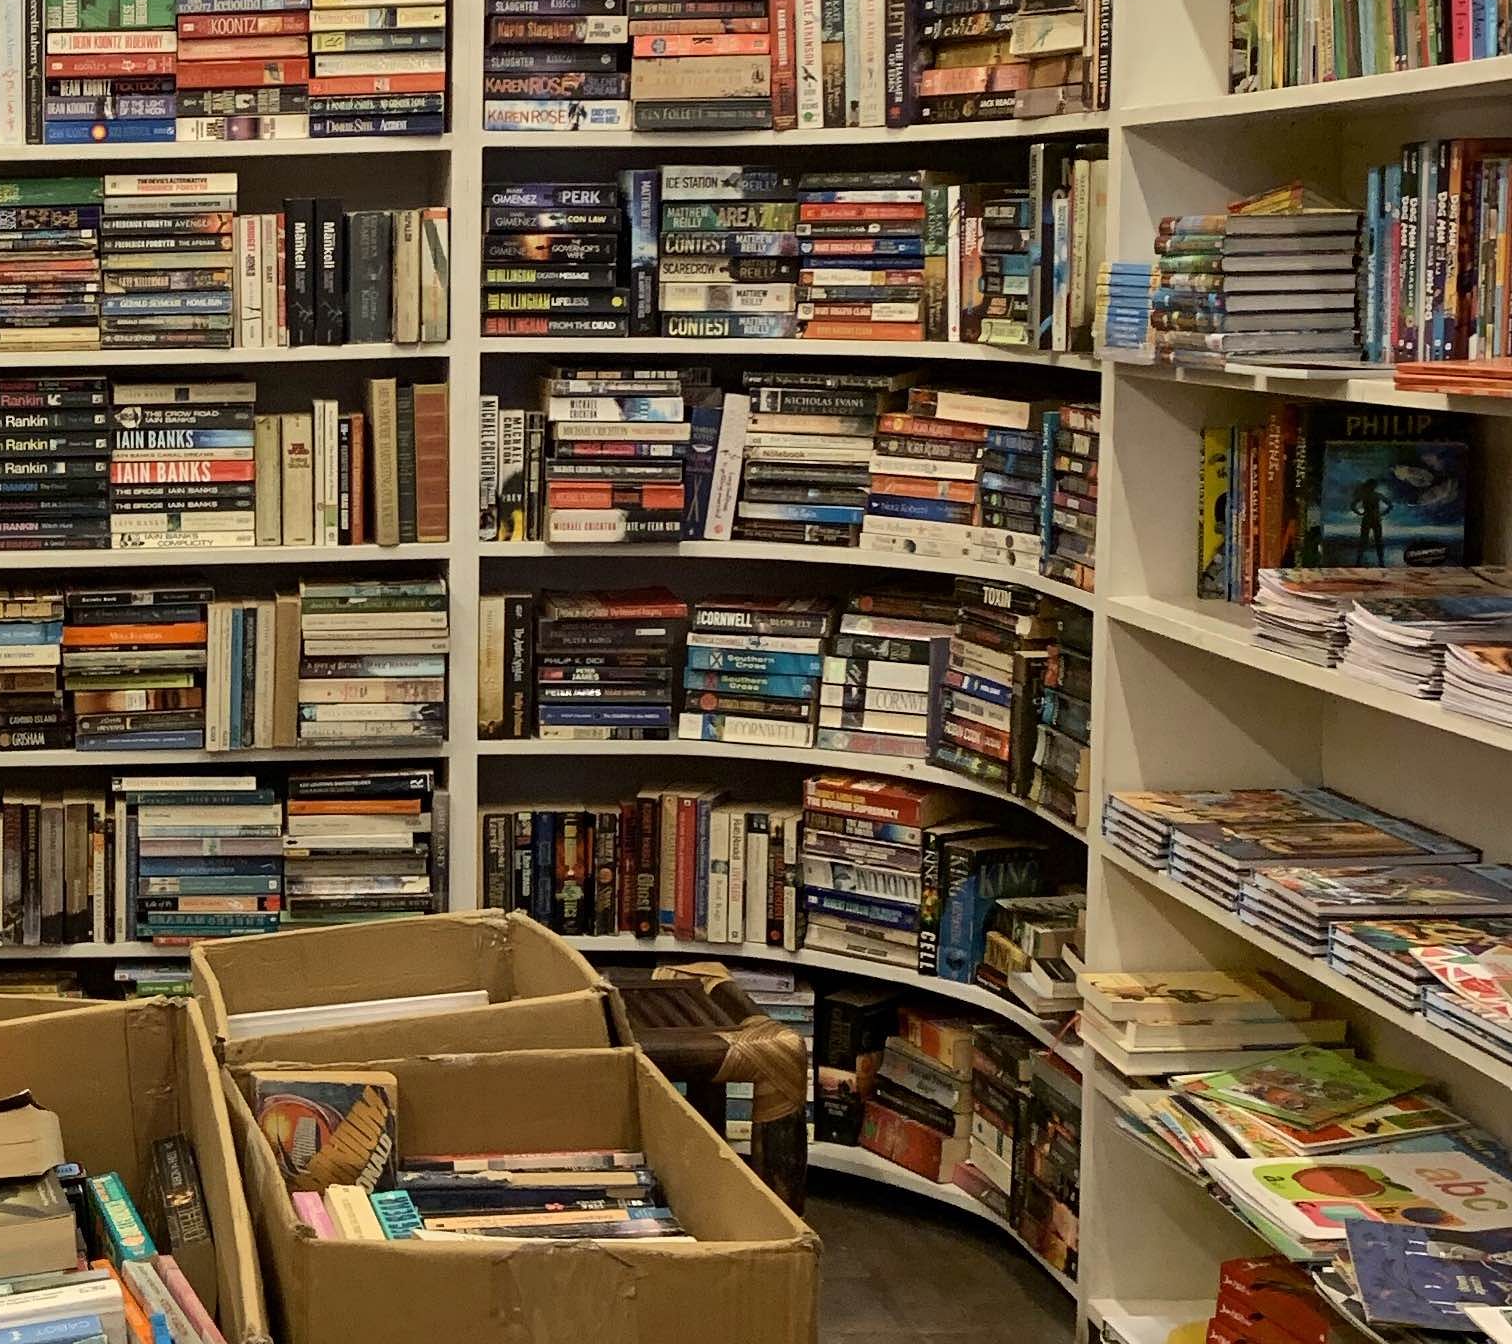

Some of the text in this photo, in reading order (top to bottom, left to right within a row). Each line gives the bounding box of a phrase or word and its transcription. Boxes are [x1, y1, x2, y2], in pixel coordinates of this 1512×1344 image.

[209, 17, 257, 34] KOONTZ
[488, 109, 566, 124] KAREN ROSE
[561, 191, 601, 204] PERK
[295, 221, 307, 270] Mankell
[323, 221, 335, 269] Mankell
[669, 317, 729, 336] CONTEST
[5, 415, 48, 427] Rankin
[481, 400, 496, 441] MICHAEL
[6, 439, 47, 451] Rankin
[116, 430, 195, 449] IAIN BANKS
[5, 462, 47, 473] Rankin
[116, 461, 212, 483] IAIN BANKS
[133, 502, 163, 510] BRIDGE
[166, 501, 183, 509] IAIN
[920, 931, 936, 969] CELL
